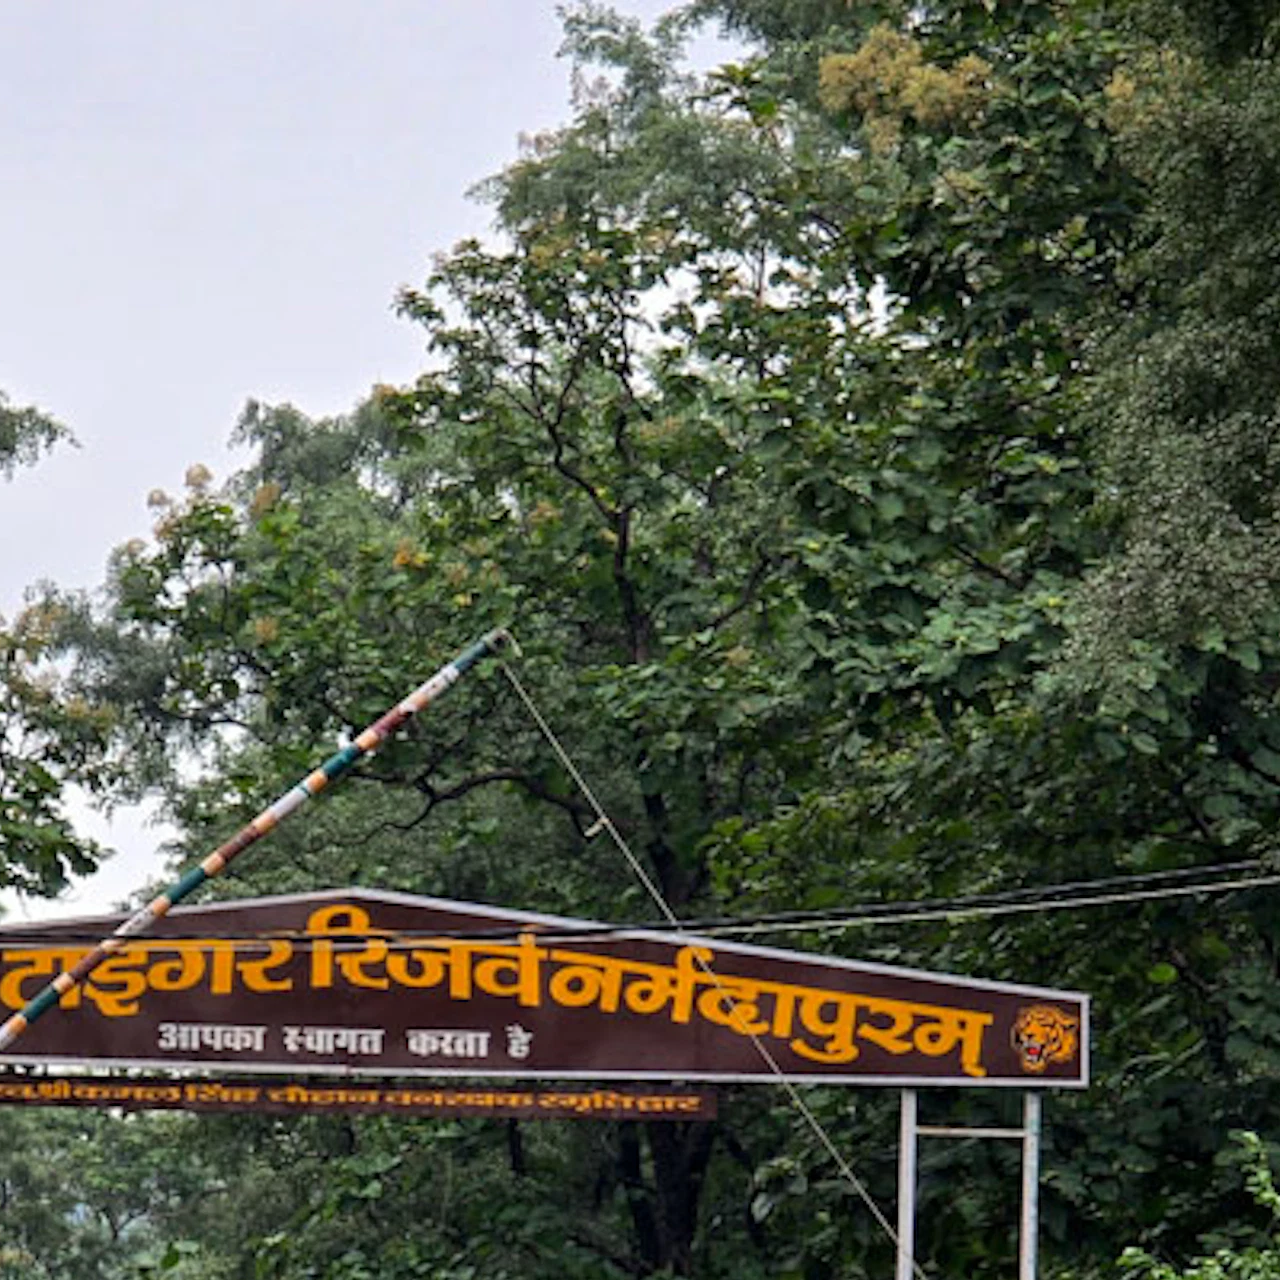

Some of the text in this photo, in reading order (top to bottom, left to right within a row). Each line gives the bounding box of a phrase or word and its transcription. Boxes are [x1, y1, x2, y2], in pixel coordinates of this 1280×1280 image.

[158, 1023, 532, 1058] आपका स्वागत करता है
